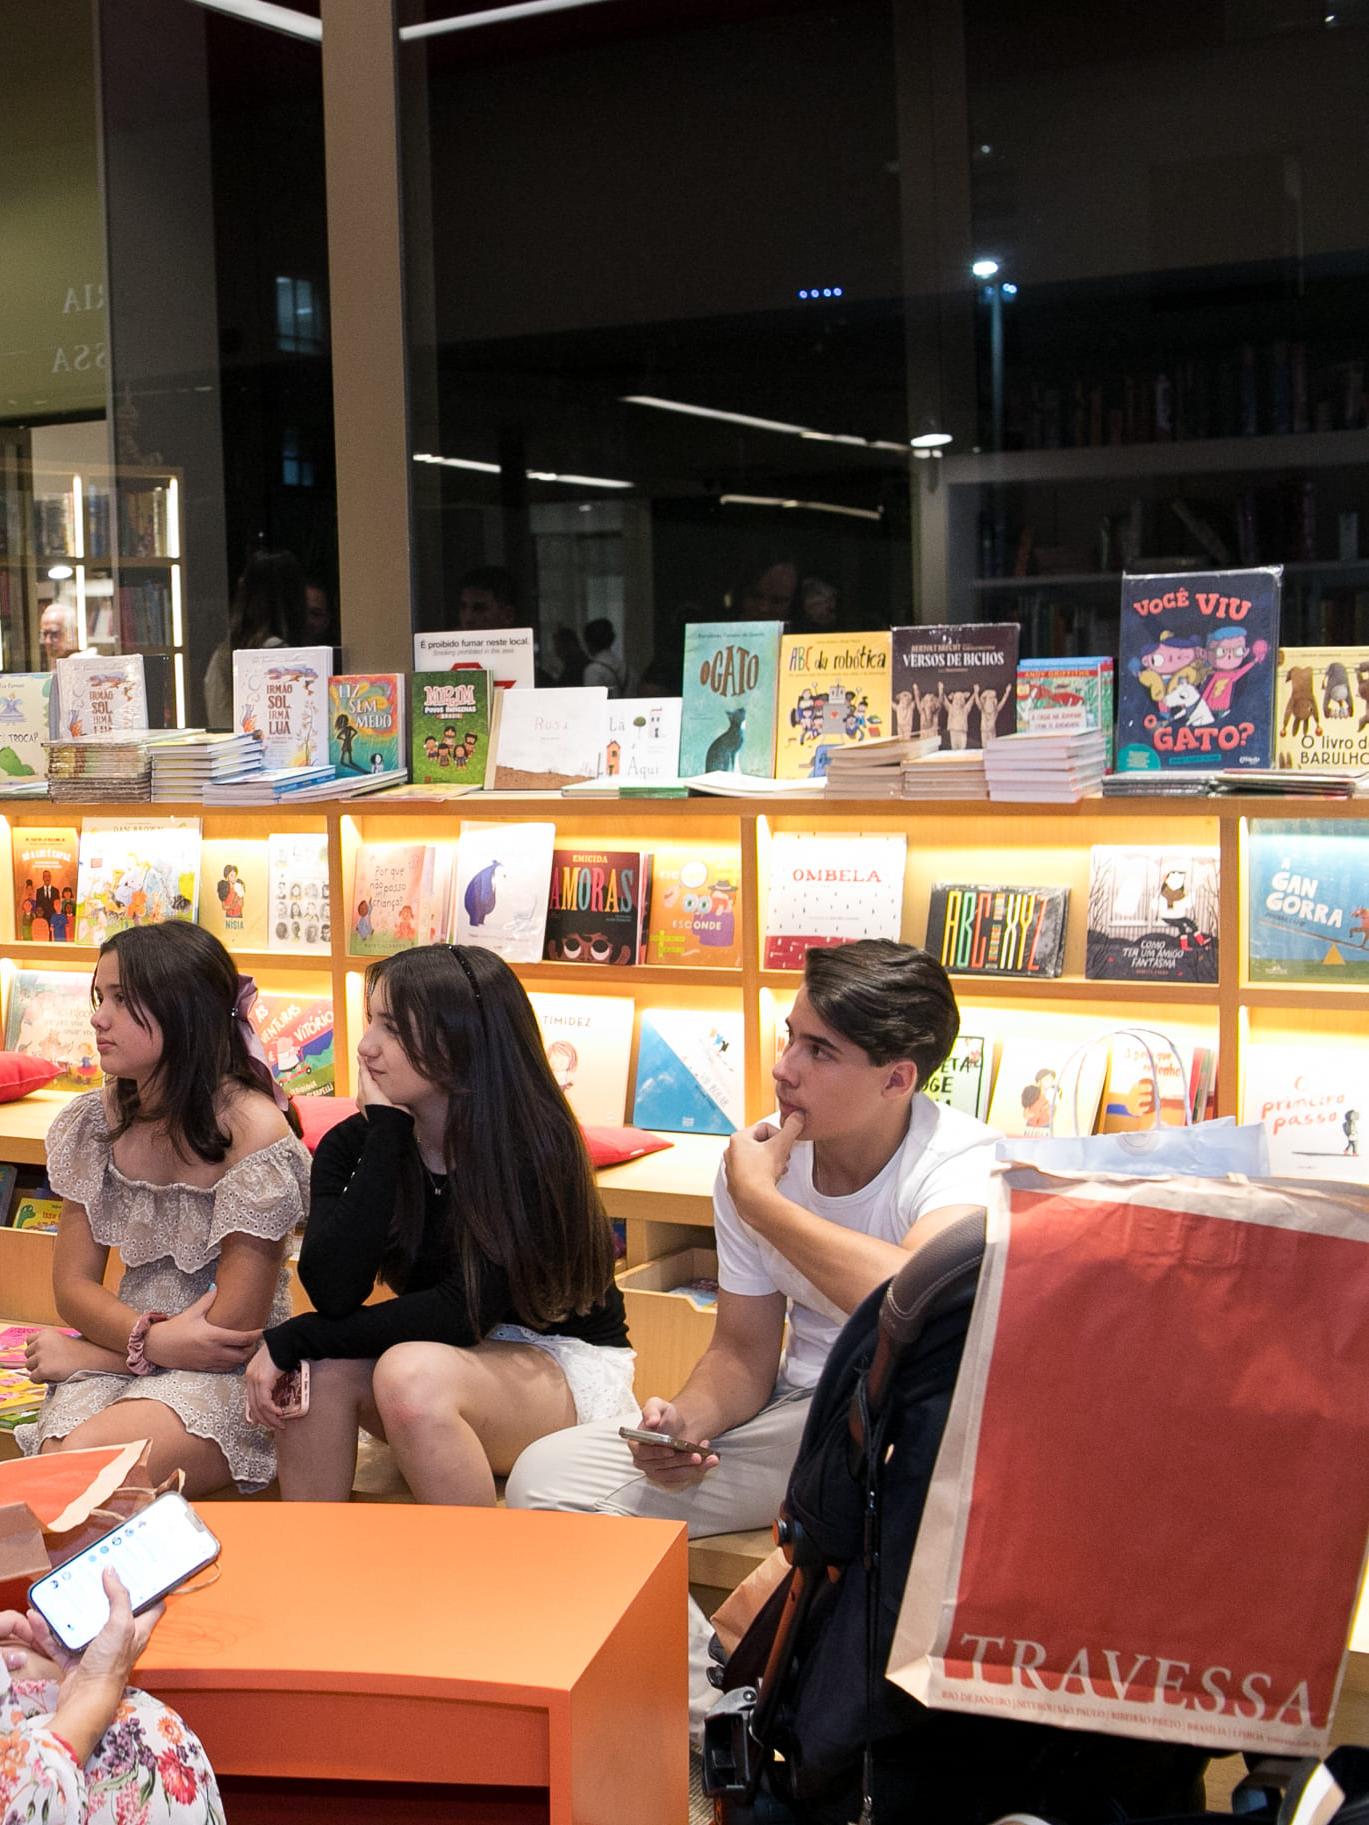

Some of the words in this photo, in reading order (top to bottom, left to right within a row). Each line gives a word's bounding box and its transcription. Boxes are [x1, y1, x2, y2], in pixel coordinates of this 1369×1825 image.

[1133, 587, 1190, 616] VOCÊ
[1195, 593, 1252, 621] VIU
[428, 639, 459, 650] proibido
[462, 638, 483, 647] fumar
[789, 645, 813, 672] ABC
[814, 650, 828, 670] da
[833, 645, 886, 670] robótica
[903, 654, 945, 668] VERSOS
[947, 653, 961, 667] DE
[963, 652, 1005, 666] BICHOS
[700, 660, 711, 686] O
[711, 645, 759, 697] GATO
[339, 683, 361, 698] LIZ
[424, 685, 477, 707] MIRIM
[92, 701, 113, 714] SOL
[267, 695, 291, 710] SOL
[349, 699, 377, 713] SEM
[269, 721, 291, 735] LUA
[357, 714, 392, 728] MEDO
[535, 716, 568, 731] Rosa
[1144, 714, 1157, 729] O
[8, 732, 39, 743] TROCA?
[1153, 721, 1255, 752] GATO?
[1302, 735, 1314, 749] O
[1322, 736, 1353, 749] livro
[1358, 735, 1369, 749] d
[1301, 752, 1369, 765] BARULHO
[628, 756, 659, 780] Aqui
[53, 850, 71, 862] CAPAZ
[572, 854, 608, 864] EMICIDA
[1281, 858, 1291, 870] A
[375, 865, 389, 877] Por
[391, 867, 405, 881] que
[792, 868, 883, 883] OMBELA
[370, 878, 384, 889] não
[384, 884, 407, 898] posso
[549, 866, 635, 914] AMORAS
[1272, 871, 1319, 899] GAN
[373, 896, 404, 912] criança?
[1265, 892, 1344, 929] GORRA
[225, 919, 244, 930] NÍSIA
[672, 919, 722, 931] ESCONDE
[941, 890, 992, 970] ABC
[999, 893, 1049, 972] XYZ
[1141, 940, 1166, 949] COMO
[1123, 947, 1139, 958] TER
[1140, 948, 1155, 957] UM
[1156, 948, 1185, 959] AMIGO
[1131, 958, 1177, 969] FANTASMA
[255, 1005, 269, 1024] AS
[543, 1015, 592, 1028] TIMIDEZ
[260, 1004, 301, 1044] VENTURAS
[293, 1010, 334, 1042] VITÓRIO
[940, 1056, 971, 1074] ETA
[1156, 1052, 1172, 1063] que
[1261, 1093, 1346, 1120] primeiro
[1273, 1111, 1337, 1135] passo
[960, 1632, 1328, 1730] TRAVESSA
[942, 1690, 959, 1700] RIO
[960, 1693, 973, 1702] DE
[975, 1695, 1011, 1707] JANEIRO
[1056, 1703, 1075, 1714] SÃO
[1076, 1707, 1105, 1719] PAULO
[1110, 1710, 1151, 1724] RIBEIRÃO
[1152, 1715, 1181, 1728] PRETO
[1187, 1721, 1228, 1737] BRASÍLIA
[1232, 1728, 1264, 1742] LISBOA
